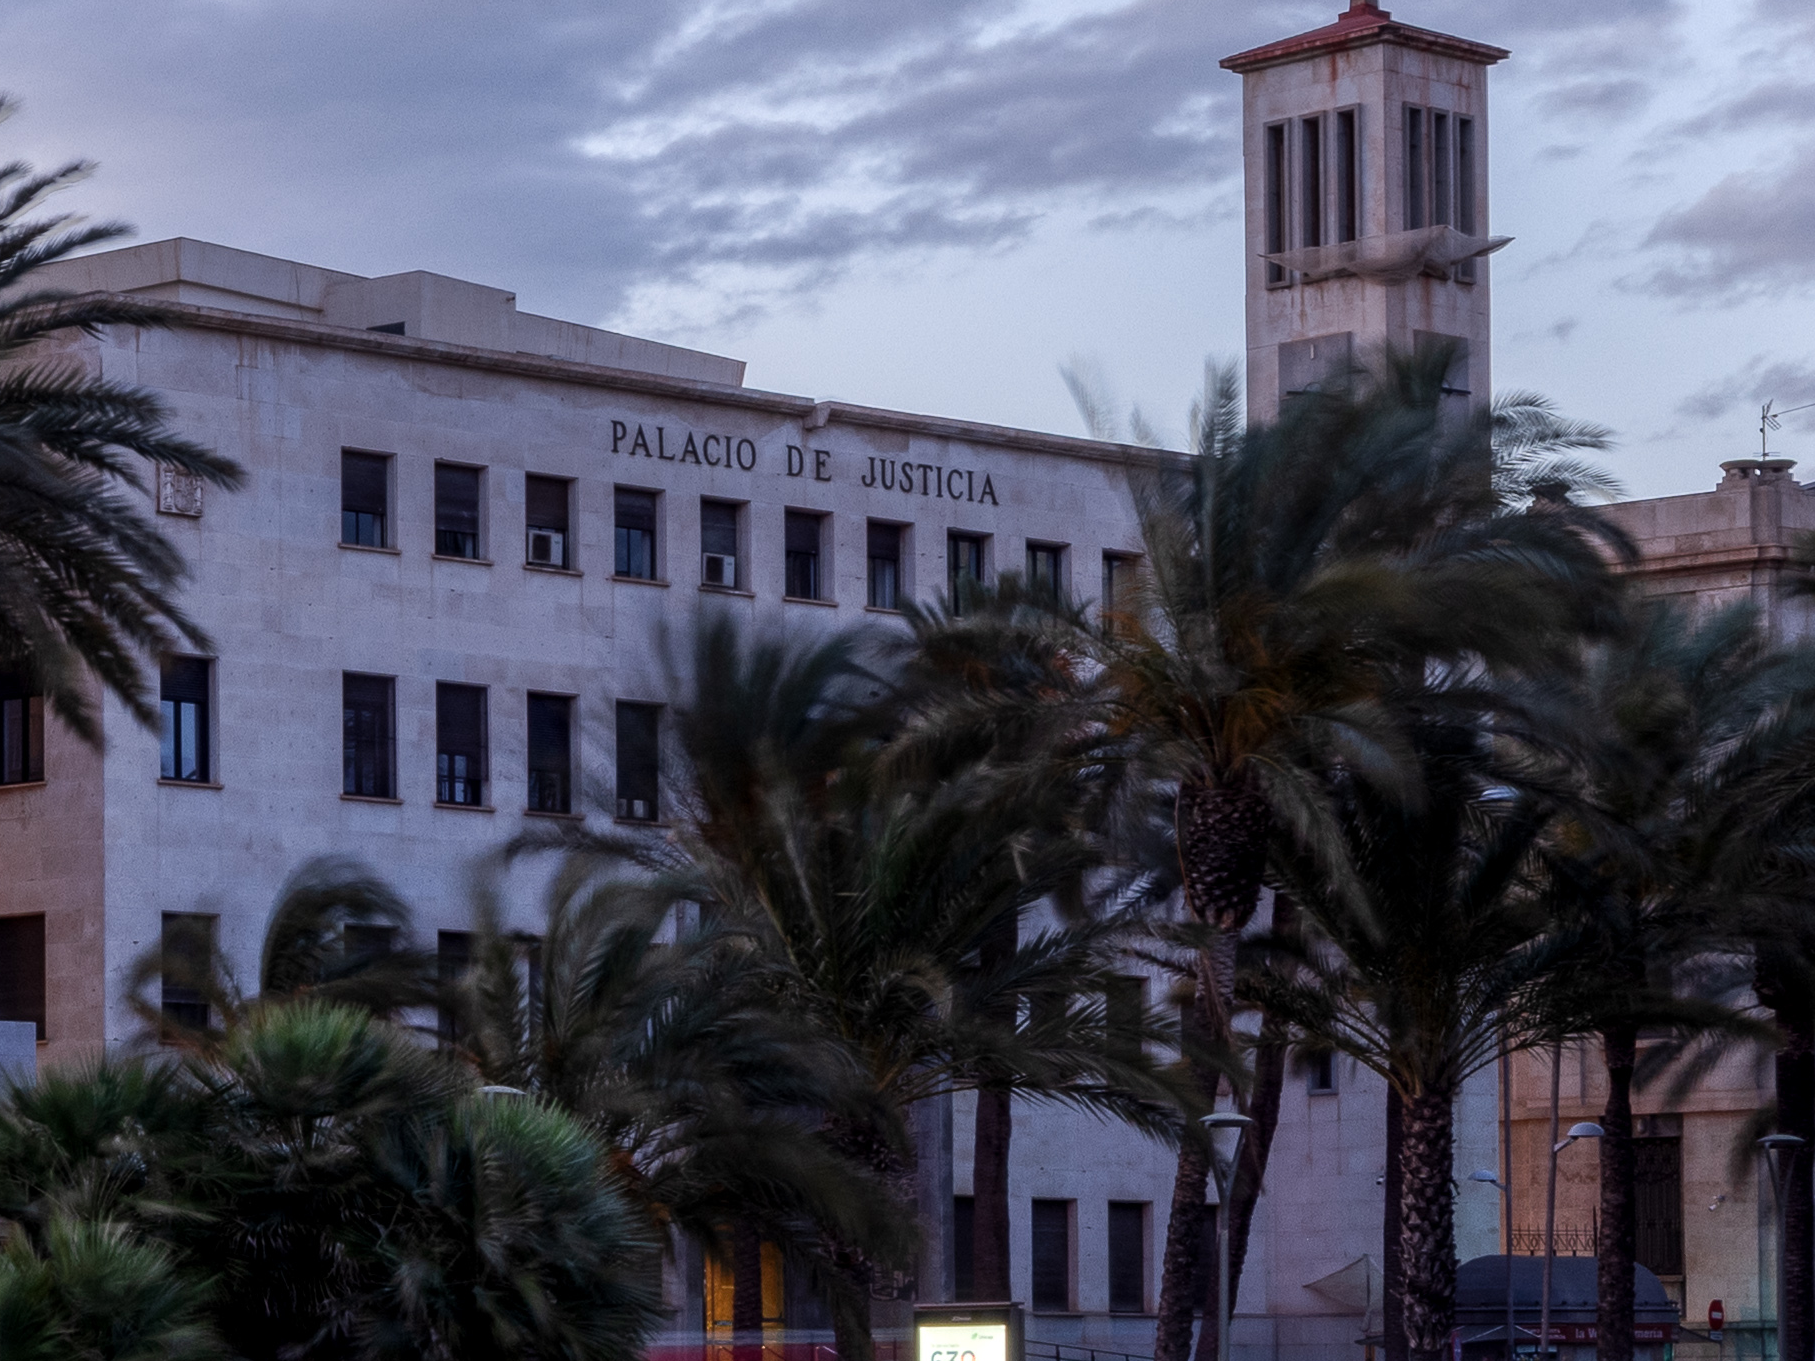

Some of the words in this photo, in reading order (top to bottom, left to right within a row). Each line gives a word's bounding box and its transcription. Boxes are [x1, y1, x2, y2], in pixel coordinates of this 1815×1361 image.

[610, 419, 757, 471] PALACIO
[785, 444, 832, 482] DE
[861, 456, 1000, 506] JUSTICIA
